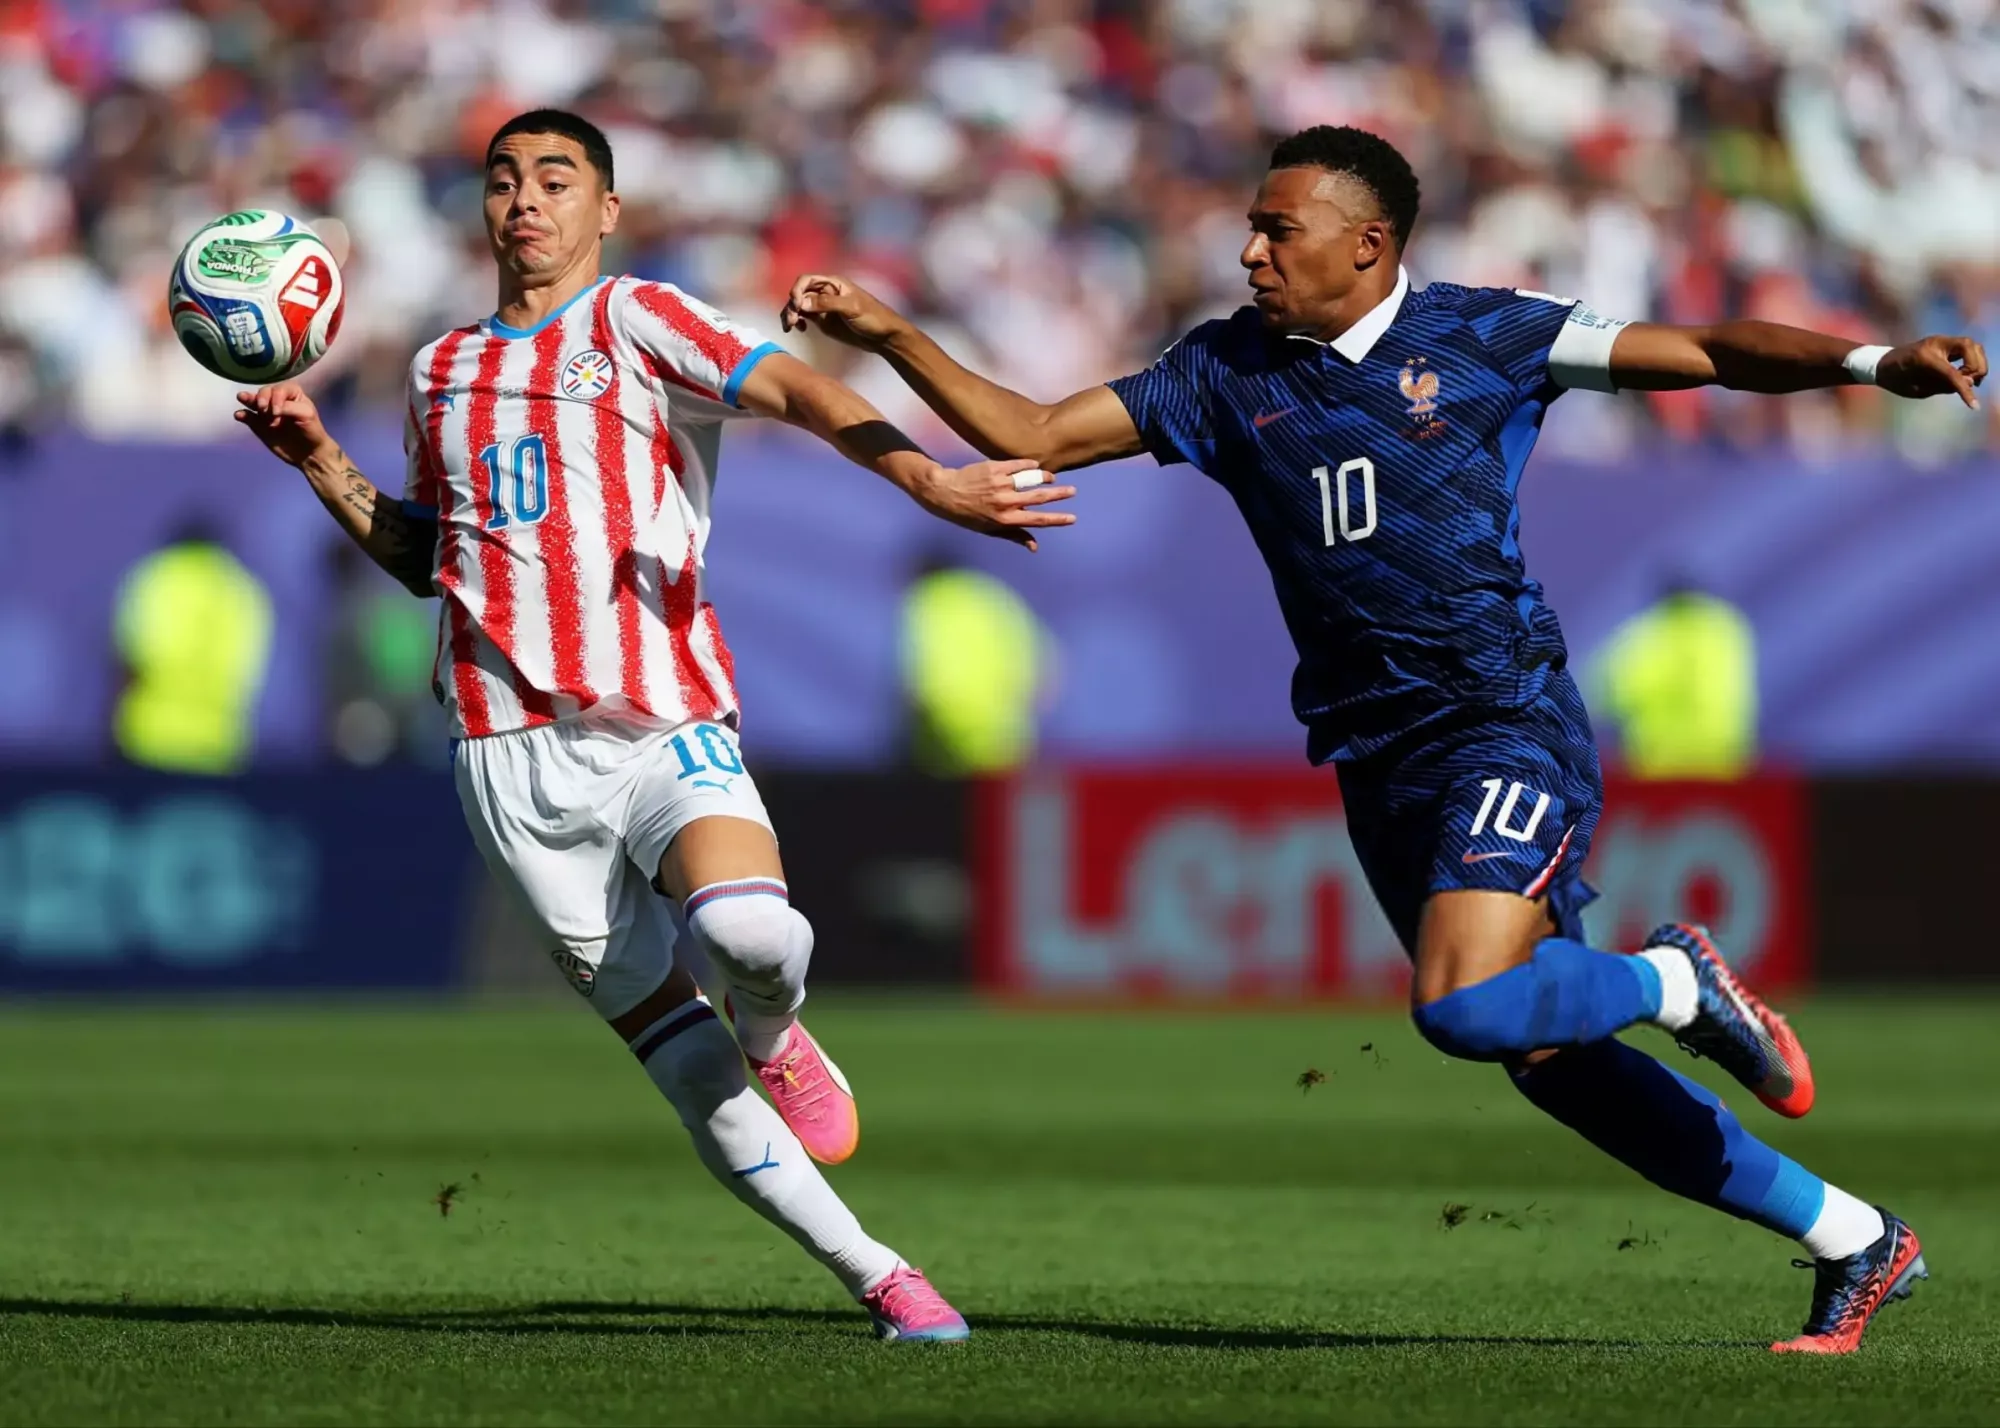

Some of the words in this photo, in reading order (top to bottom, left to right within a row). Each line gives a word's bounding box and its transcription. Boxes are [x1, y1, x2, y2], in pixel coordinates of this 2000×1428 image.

[207, 261, 258, 277] TRIONDA
[581, 354, 598, 363] APF
[479, 433, 550, 530] 10
[1312, 457, 1377, 547] 10
[662, 723, 743, 780] 10
[1469, 778, 1550, 842] 10
[1012, 783, 1772, 982] Lenvo
